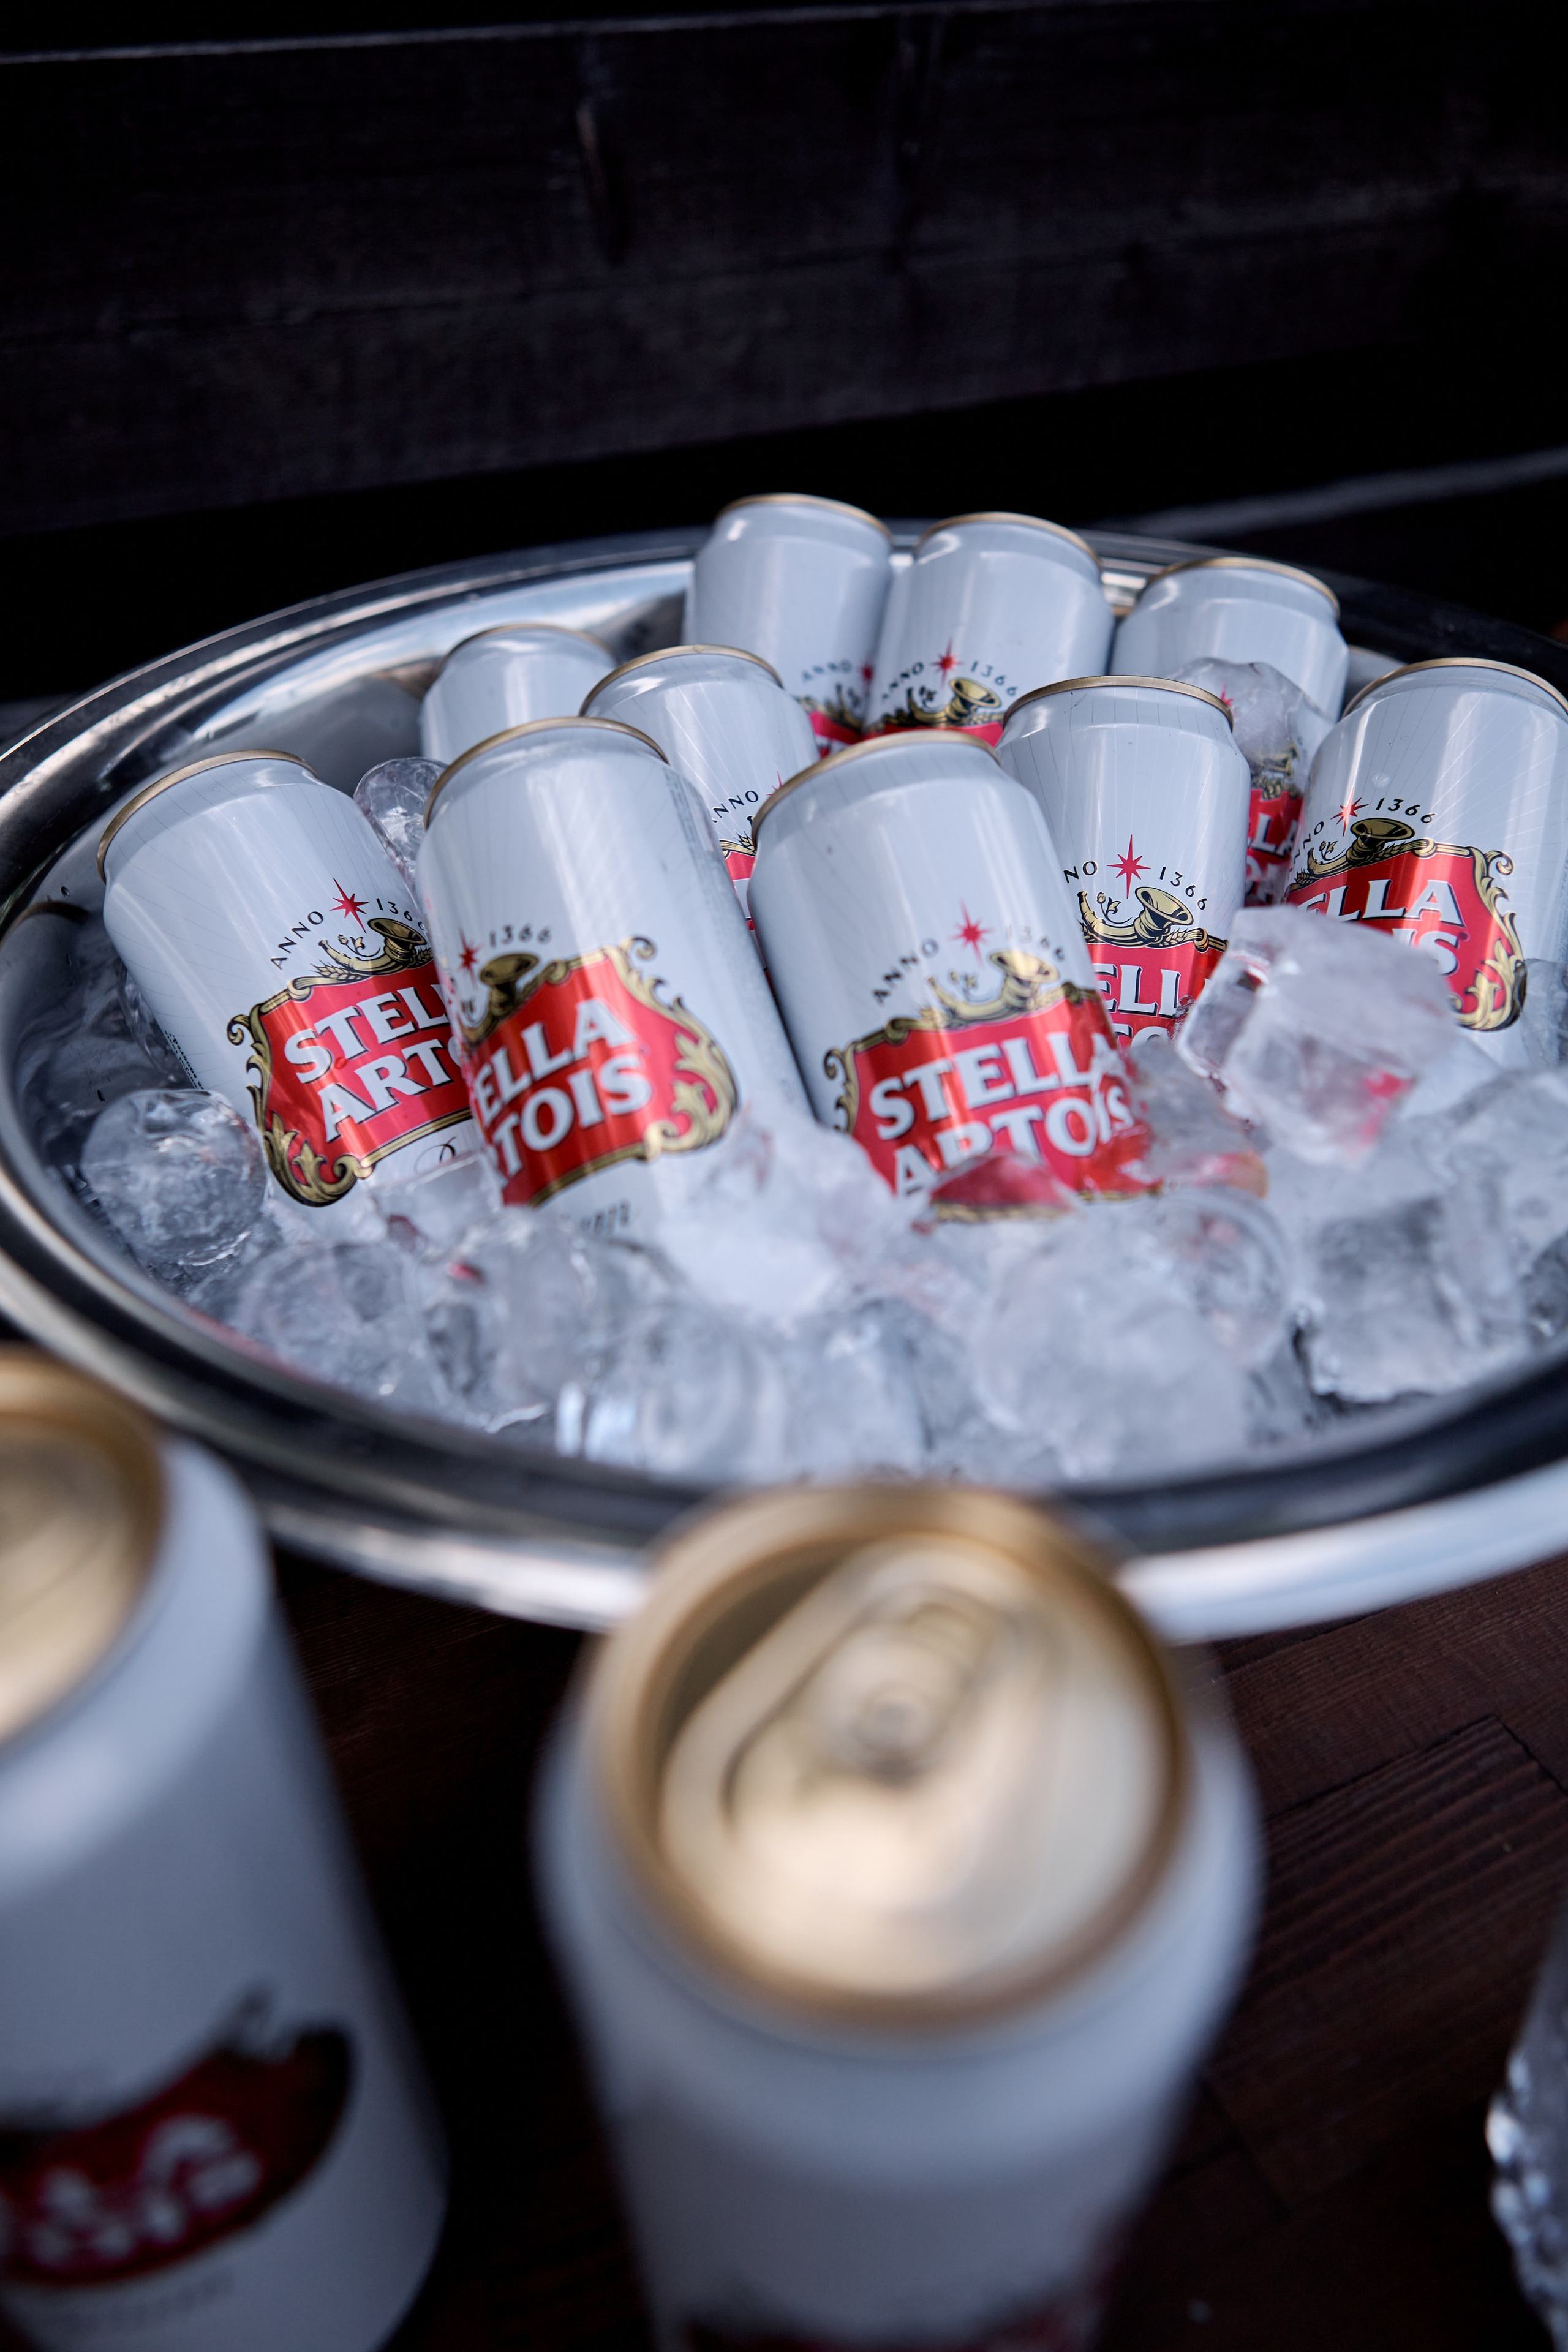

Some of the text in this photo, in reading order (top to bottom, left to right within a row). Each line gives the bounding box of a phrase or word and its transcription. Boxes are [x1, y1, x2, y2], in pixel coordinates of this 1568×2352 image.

[971, 660, 1018, 697] 1366
[712, 790, 759, 823] NNO
[1376, 797, 1437, 824] 1366
[1159, 866, 1208, 910] 1366
[271, 911, 324, 971] ANNO
[491, 924, 552, 948] 1366
[872, 938, 939, 1007] ANNO
